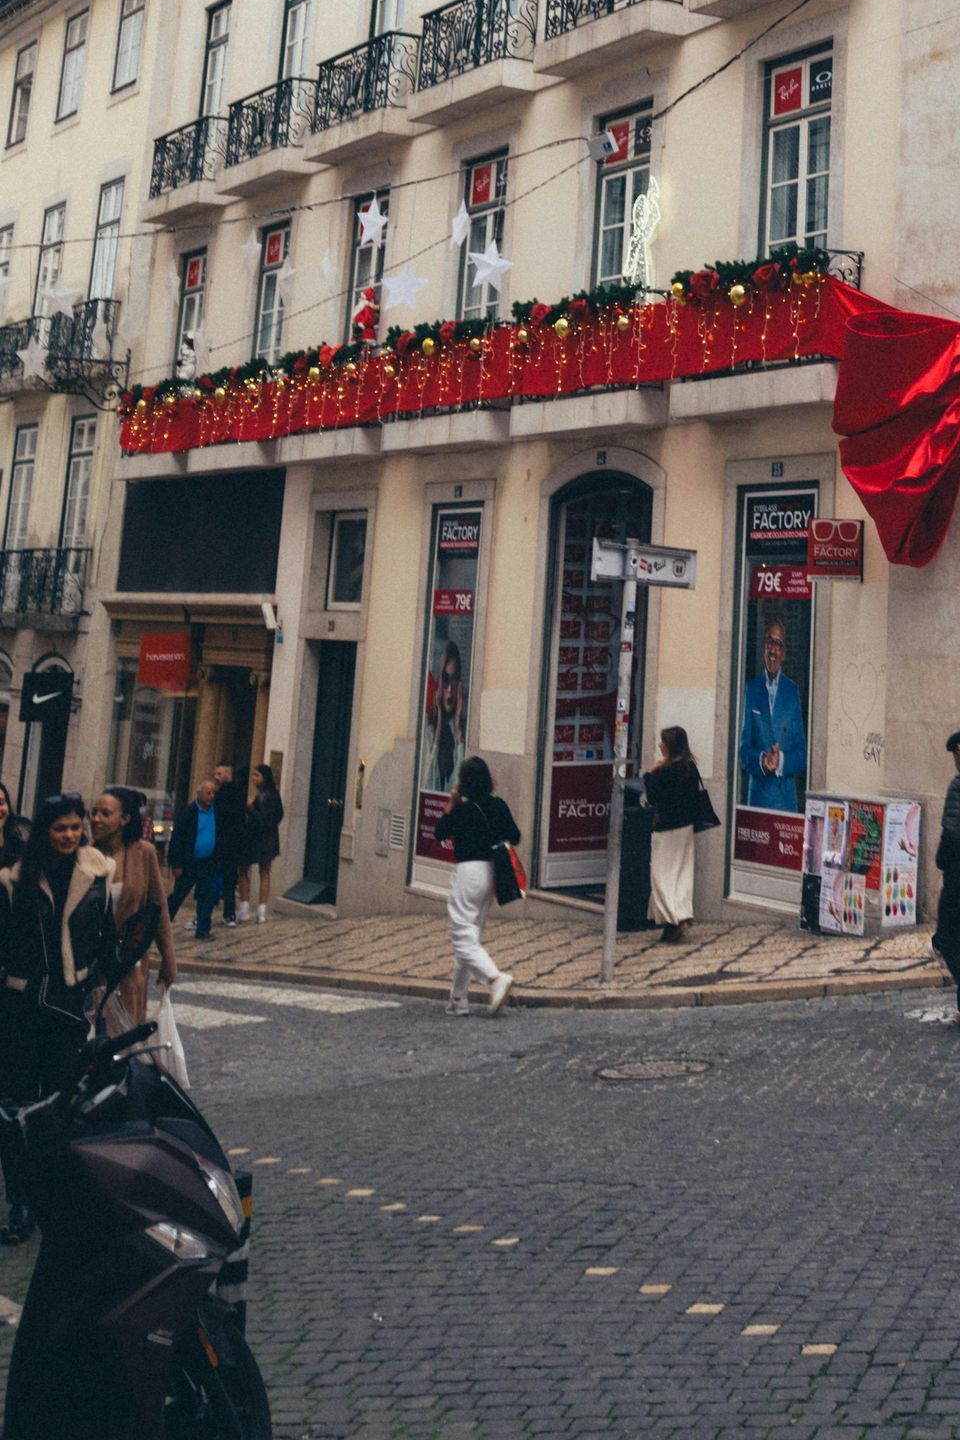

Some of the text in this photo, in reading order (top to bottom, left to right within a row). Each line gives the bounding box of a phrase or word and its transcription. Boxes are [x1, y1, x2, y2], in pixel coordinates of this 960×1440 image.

[753, 510, 811, 530] FACTORY
[442, 525, 479, 540] FACTORY
[813, 547, 858, 557] FACTORY
[757, 572, 782, 592] 79€
[455, 594, 472, 610] 79€
